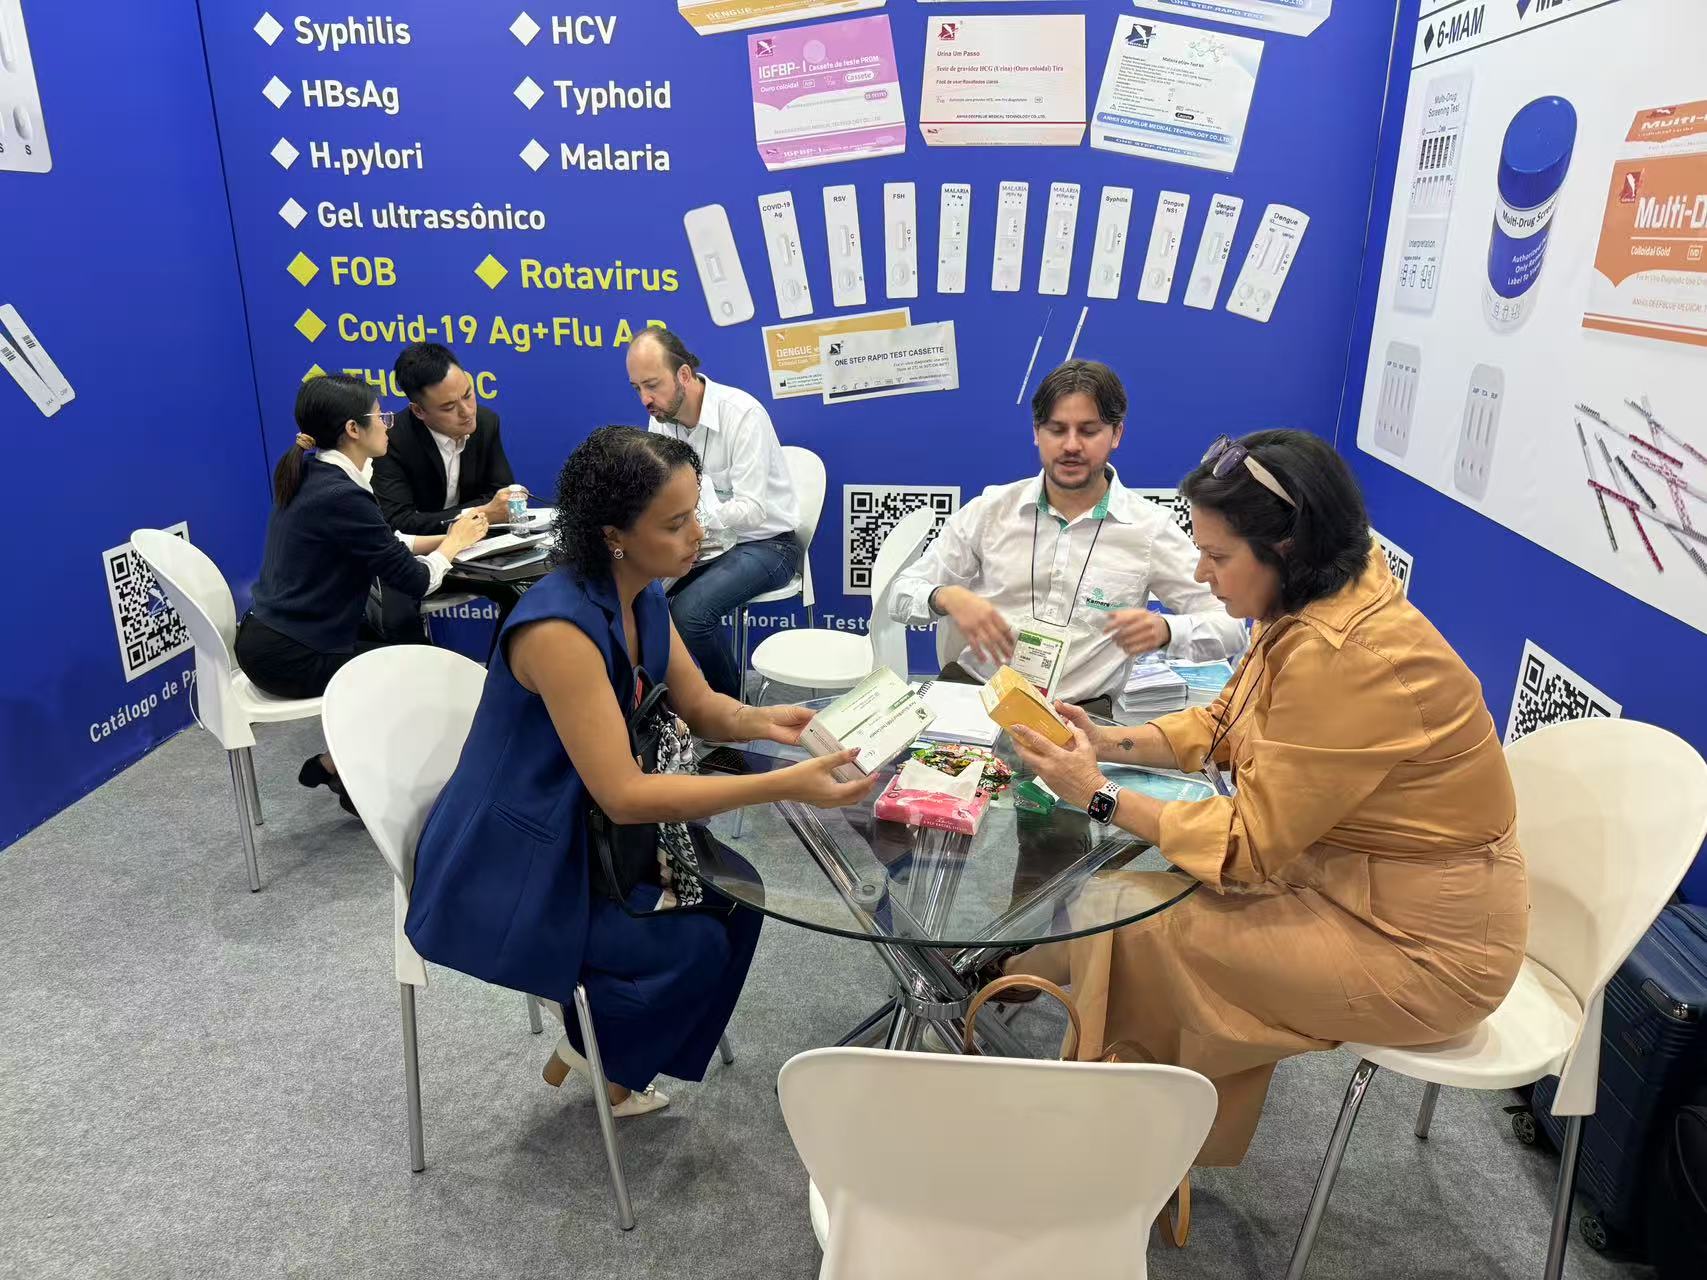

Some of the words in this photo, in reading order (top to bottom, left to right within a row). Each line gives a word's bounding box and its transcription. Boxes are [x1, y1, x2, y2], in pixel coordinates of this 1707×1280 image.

[294, 17, 412, 51] Syphilis
[551, 16, 617, 45] HCV
[1437, 4, 1486, 48] 6-MAM
[301, 80, 400, 115] HBsAg
[553, 81, 671, 115] Typhoid
[1149, 122, 1172, 132] MEDICAL
[1172, 126, 1209, 140] TECHNOLOGY
[25, 144, 32, 155] S
[309, 142, 424, 175] H.pylori
[560, 143, 671, 172] Malaria
[833, 195, 847, 203] RSV
[1053, 186, 1079, 194] MALARIA
[1105, 195, 1128, 204] Syphilis
[762, 201, 791, 212] COVID-19
[1163, 199, 1184, 208] Dengue
[1216, 201, 1236, 211] Dengue
[317, 202, 364, 229] Gel
[371, 202, 546, 230] ultrassônico
[1273, 212, 1299, 226] Dengue
[1502, 208, 1535, 228] Multi-Drug
[1631, 246, 1655, 257] Colloidal
[1656, 247, 1671, 257] Gold
[330, 256, 397, 286] FOB
[520, 259, 680, 292] Rotavirus
[1507, 277, 1523, 286] Label
[338, 313, 478, 344] Covid-19
[489, 316, 602, 352] Ag+Flu
[776, 345, 812, 357] DENGUE
[834, 358, 849, 367] ONE
[849, 356, 866, 365] STEP
[867, 354, 888, 363] RAPID
[890, 351, 907, 359] TEST
[908, 347, 944, 357] CASSETTE
[89, 693, 158, 743] Catálogo
[162, 680, 178, 701] de
